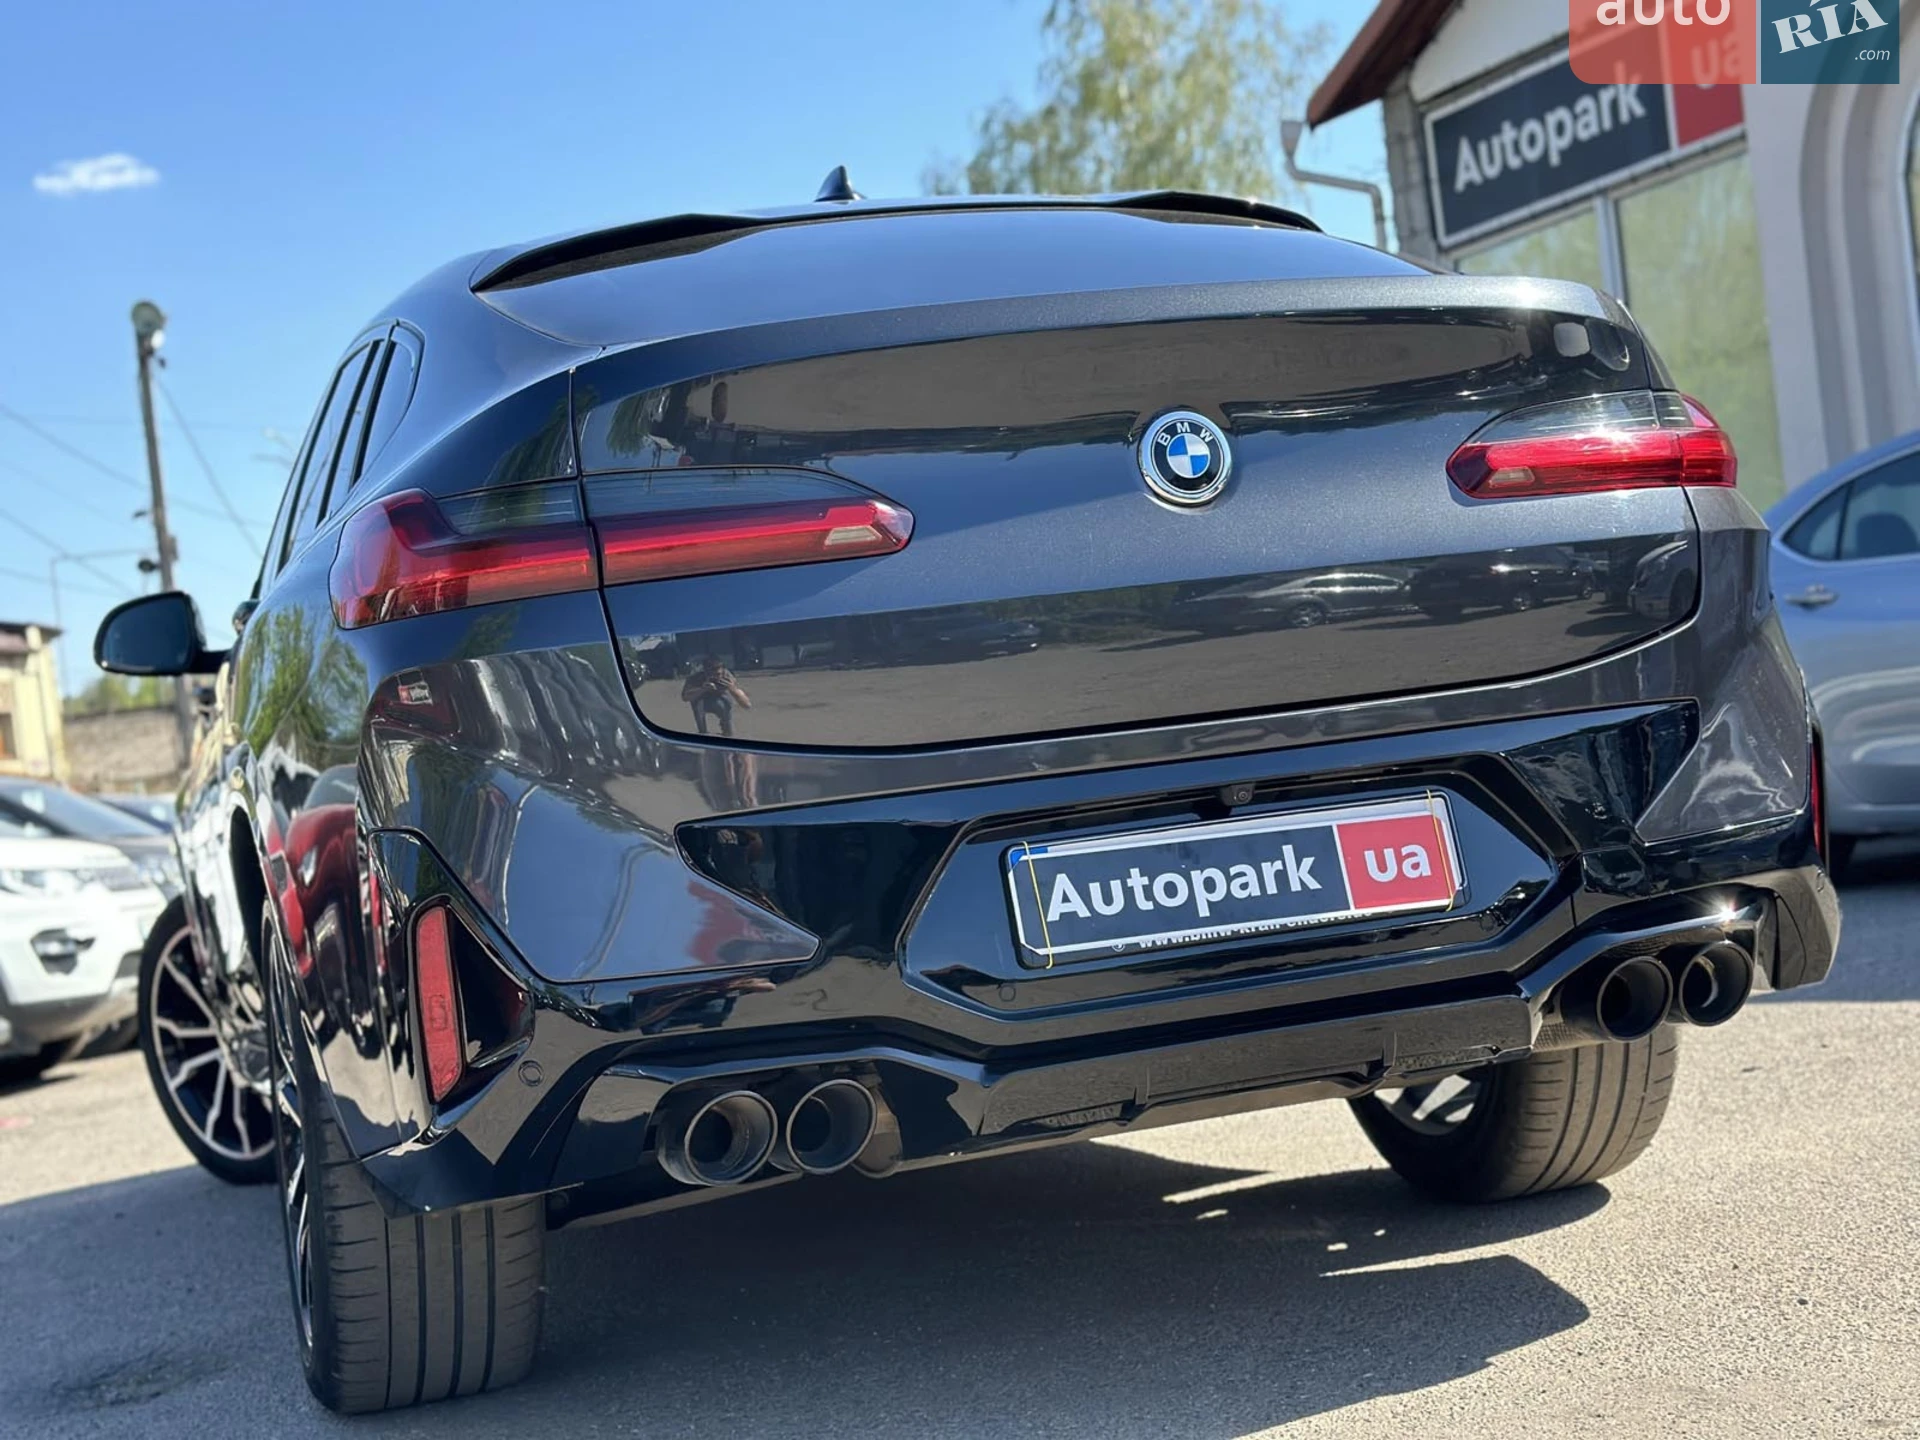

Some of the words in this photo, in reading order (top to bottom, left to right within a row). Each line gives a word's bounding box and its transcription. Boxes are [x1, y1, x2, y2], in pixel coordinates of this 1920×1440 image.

[1453, 61, 1647, 193] Autopark
[1157, 421, 1214, 446] BMW
[1046, 843, 1322, 922] Autopark
[1364, 842, 1432, 883] ua
